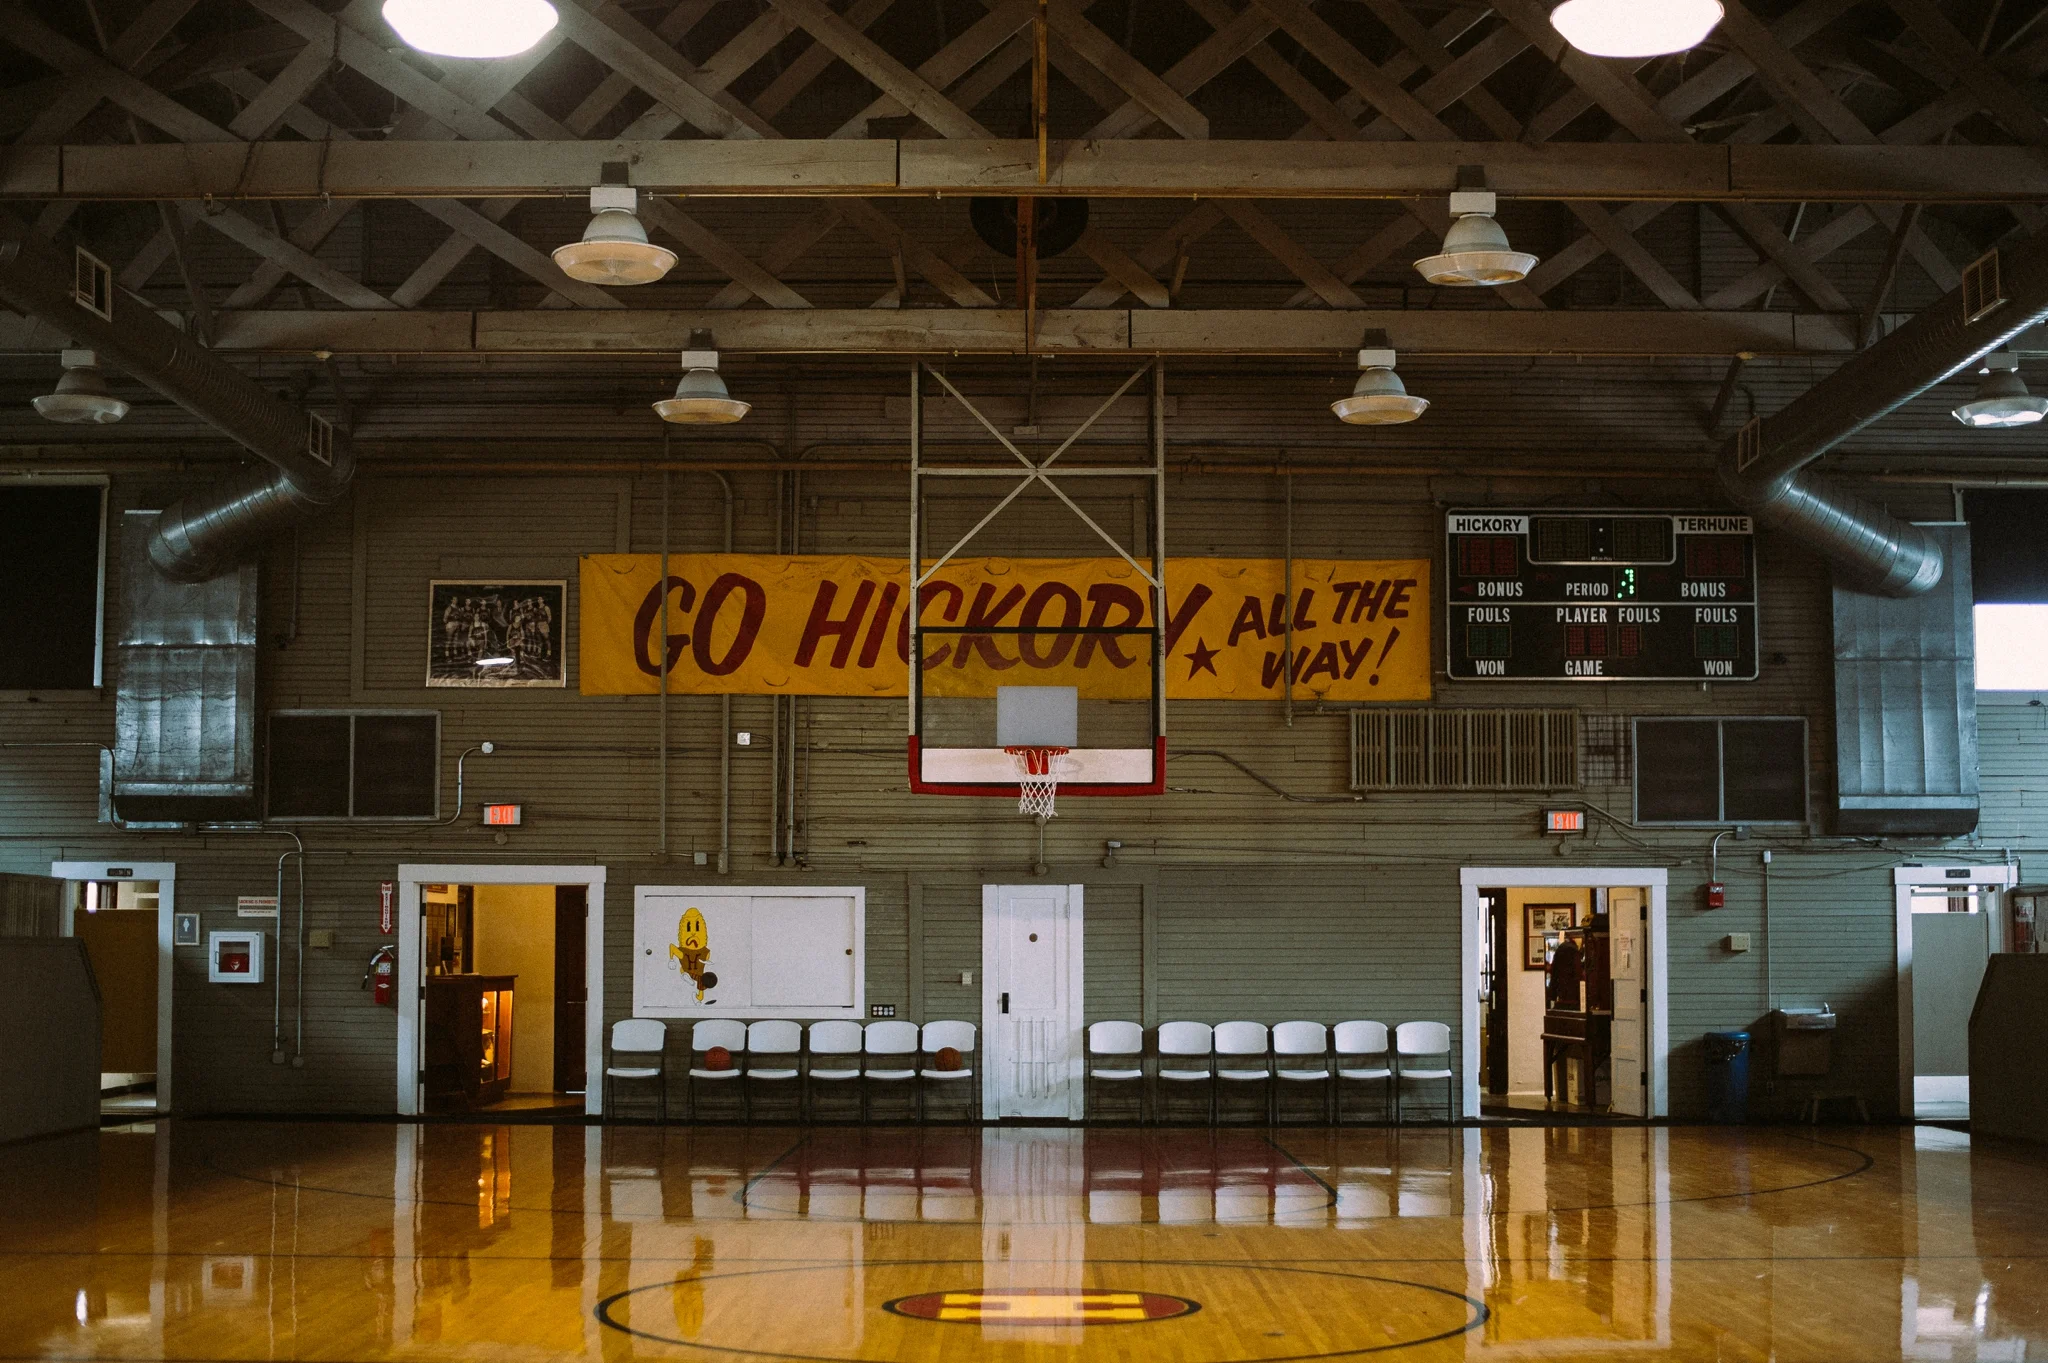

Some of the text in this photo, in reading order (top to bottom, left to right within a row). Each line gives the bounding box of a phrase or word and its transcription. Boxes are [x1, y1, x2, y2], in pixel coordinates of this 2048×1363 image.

[1456, 518, 1522, 532] HICKORY
[1678, 518, 1749, 532] TERHUNE
[1478, 582, 1524, 597] BONUS
[1565, 582, 1610, 597] PERIOD
[1681, 582, 1727, 597] BONUS
[1228, 578, 1418, 647] ALL THE
[1468, 608, 1511, 623] FOULS
[1556, 607, 1661, 623] PLAYER FOULS
[1695, 607, 1738, 623] FOULS
[633, 573, 1213, 678] GO HICKORY
[1261, 626, 1401, 689] WAY!
[1475, 660, 1505, 676] WON
[1564, 660, 1604, 676] GAME
[1703, 660, 1733, 676] WON
[490, 804, 515, 825] EXIT
[1554, 811, 1578, 830] EXIT
